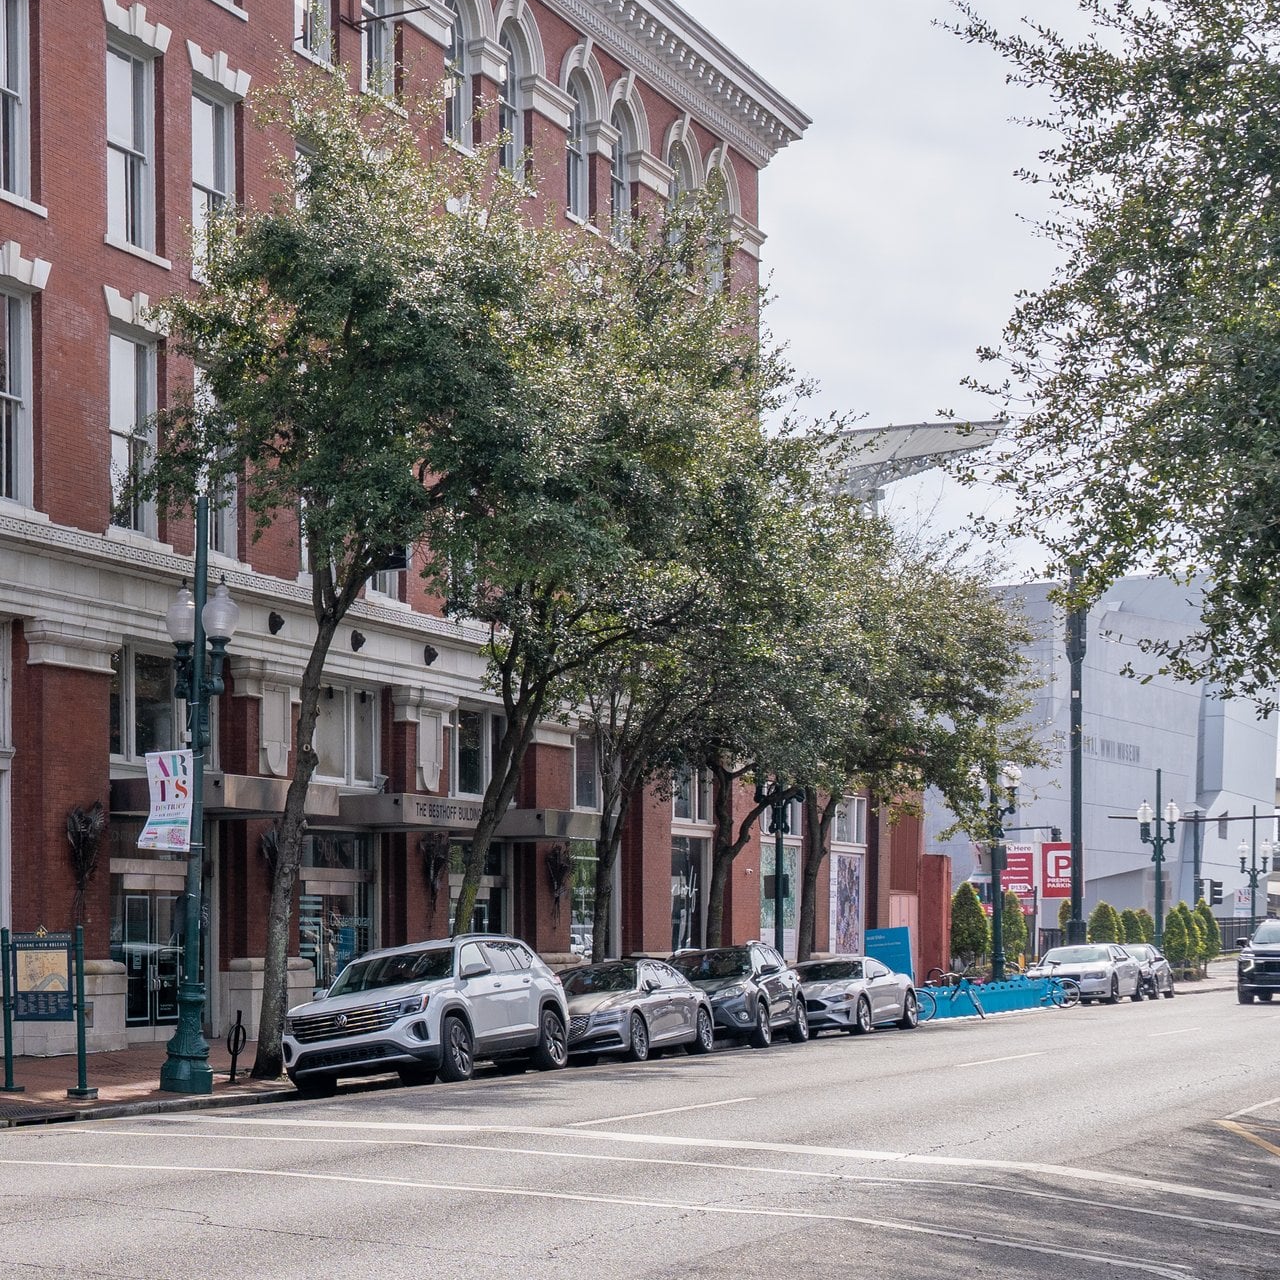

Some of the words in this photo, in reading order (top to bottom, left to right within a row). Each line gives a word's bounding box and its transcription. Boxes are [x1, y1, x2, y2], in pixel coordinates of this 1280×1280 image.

[1117, 742, 1140, 763] MUSEUM
[156, 803, 186, 812] DISTRICT
[416, 802, 427, 817] THE
[428, 804, 457, 820] BESTHOFF
[330, 933, 344, 943] Arts
